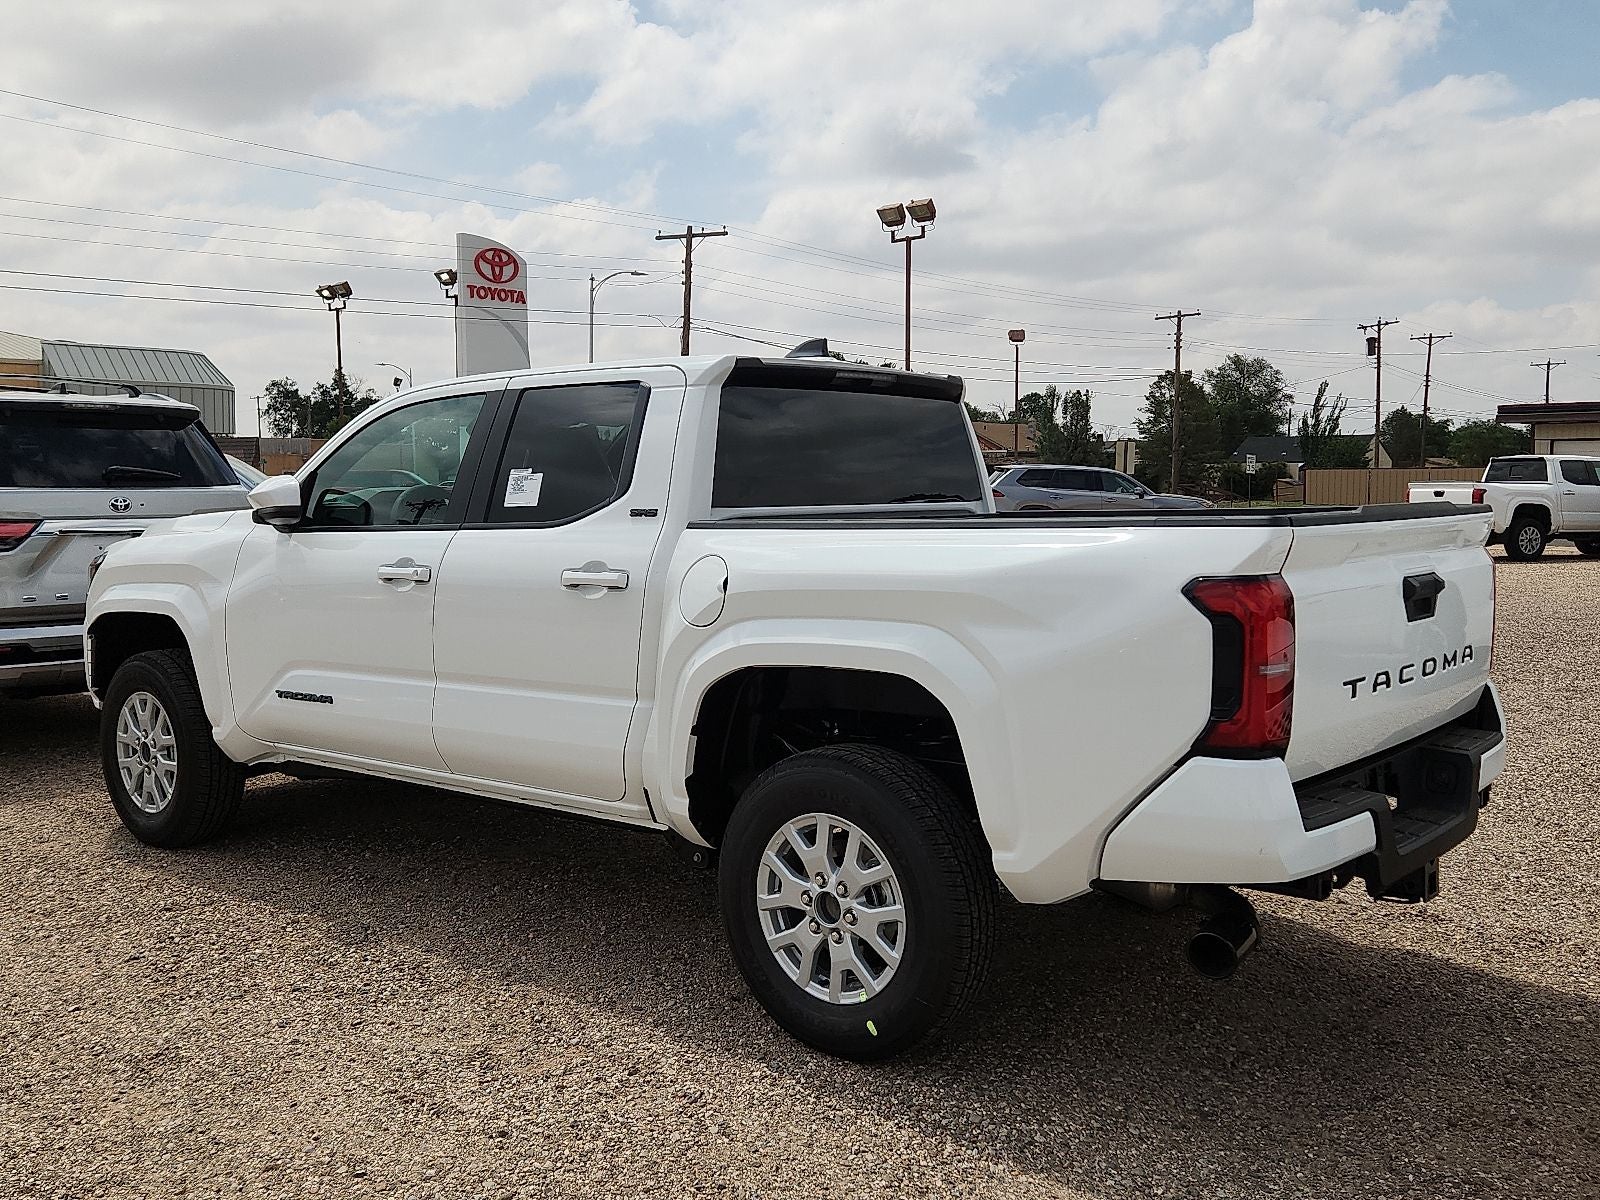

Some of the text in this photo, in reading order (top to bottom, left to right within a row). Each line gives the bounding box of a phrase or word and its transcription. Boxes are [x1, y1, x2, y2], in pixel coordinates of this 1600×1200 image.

[466, 284, 527, 304] TOYOTA
[1342, 644, 1473, 699] TACOMA
[275, 689, 333, 704] TACOMA
